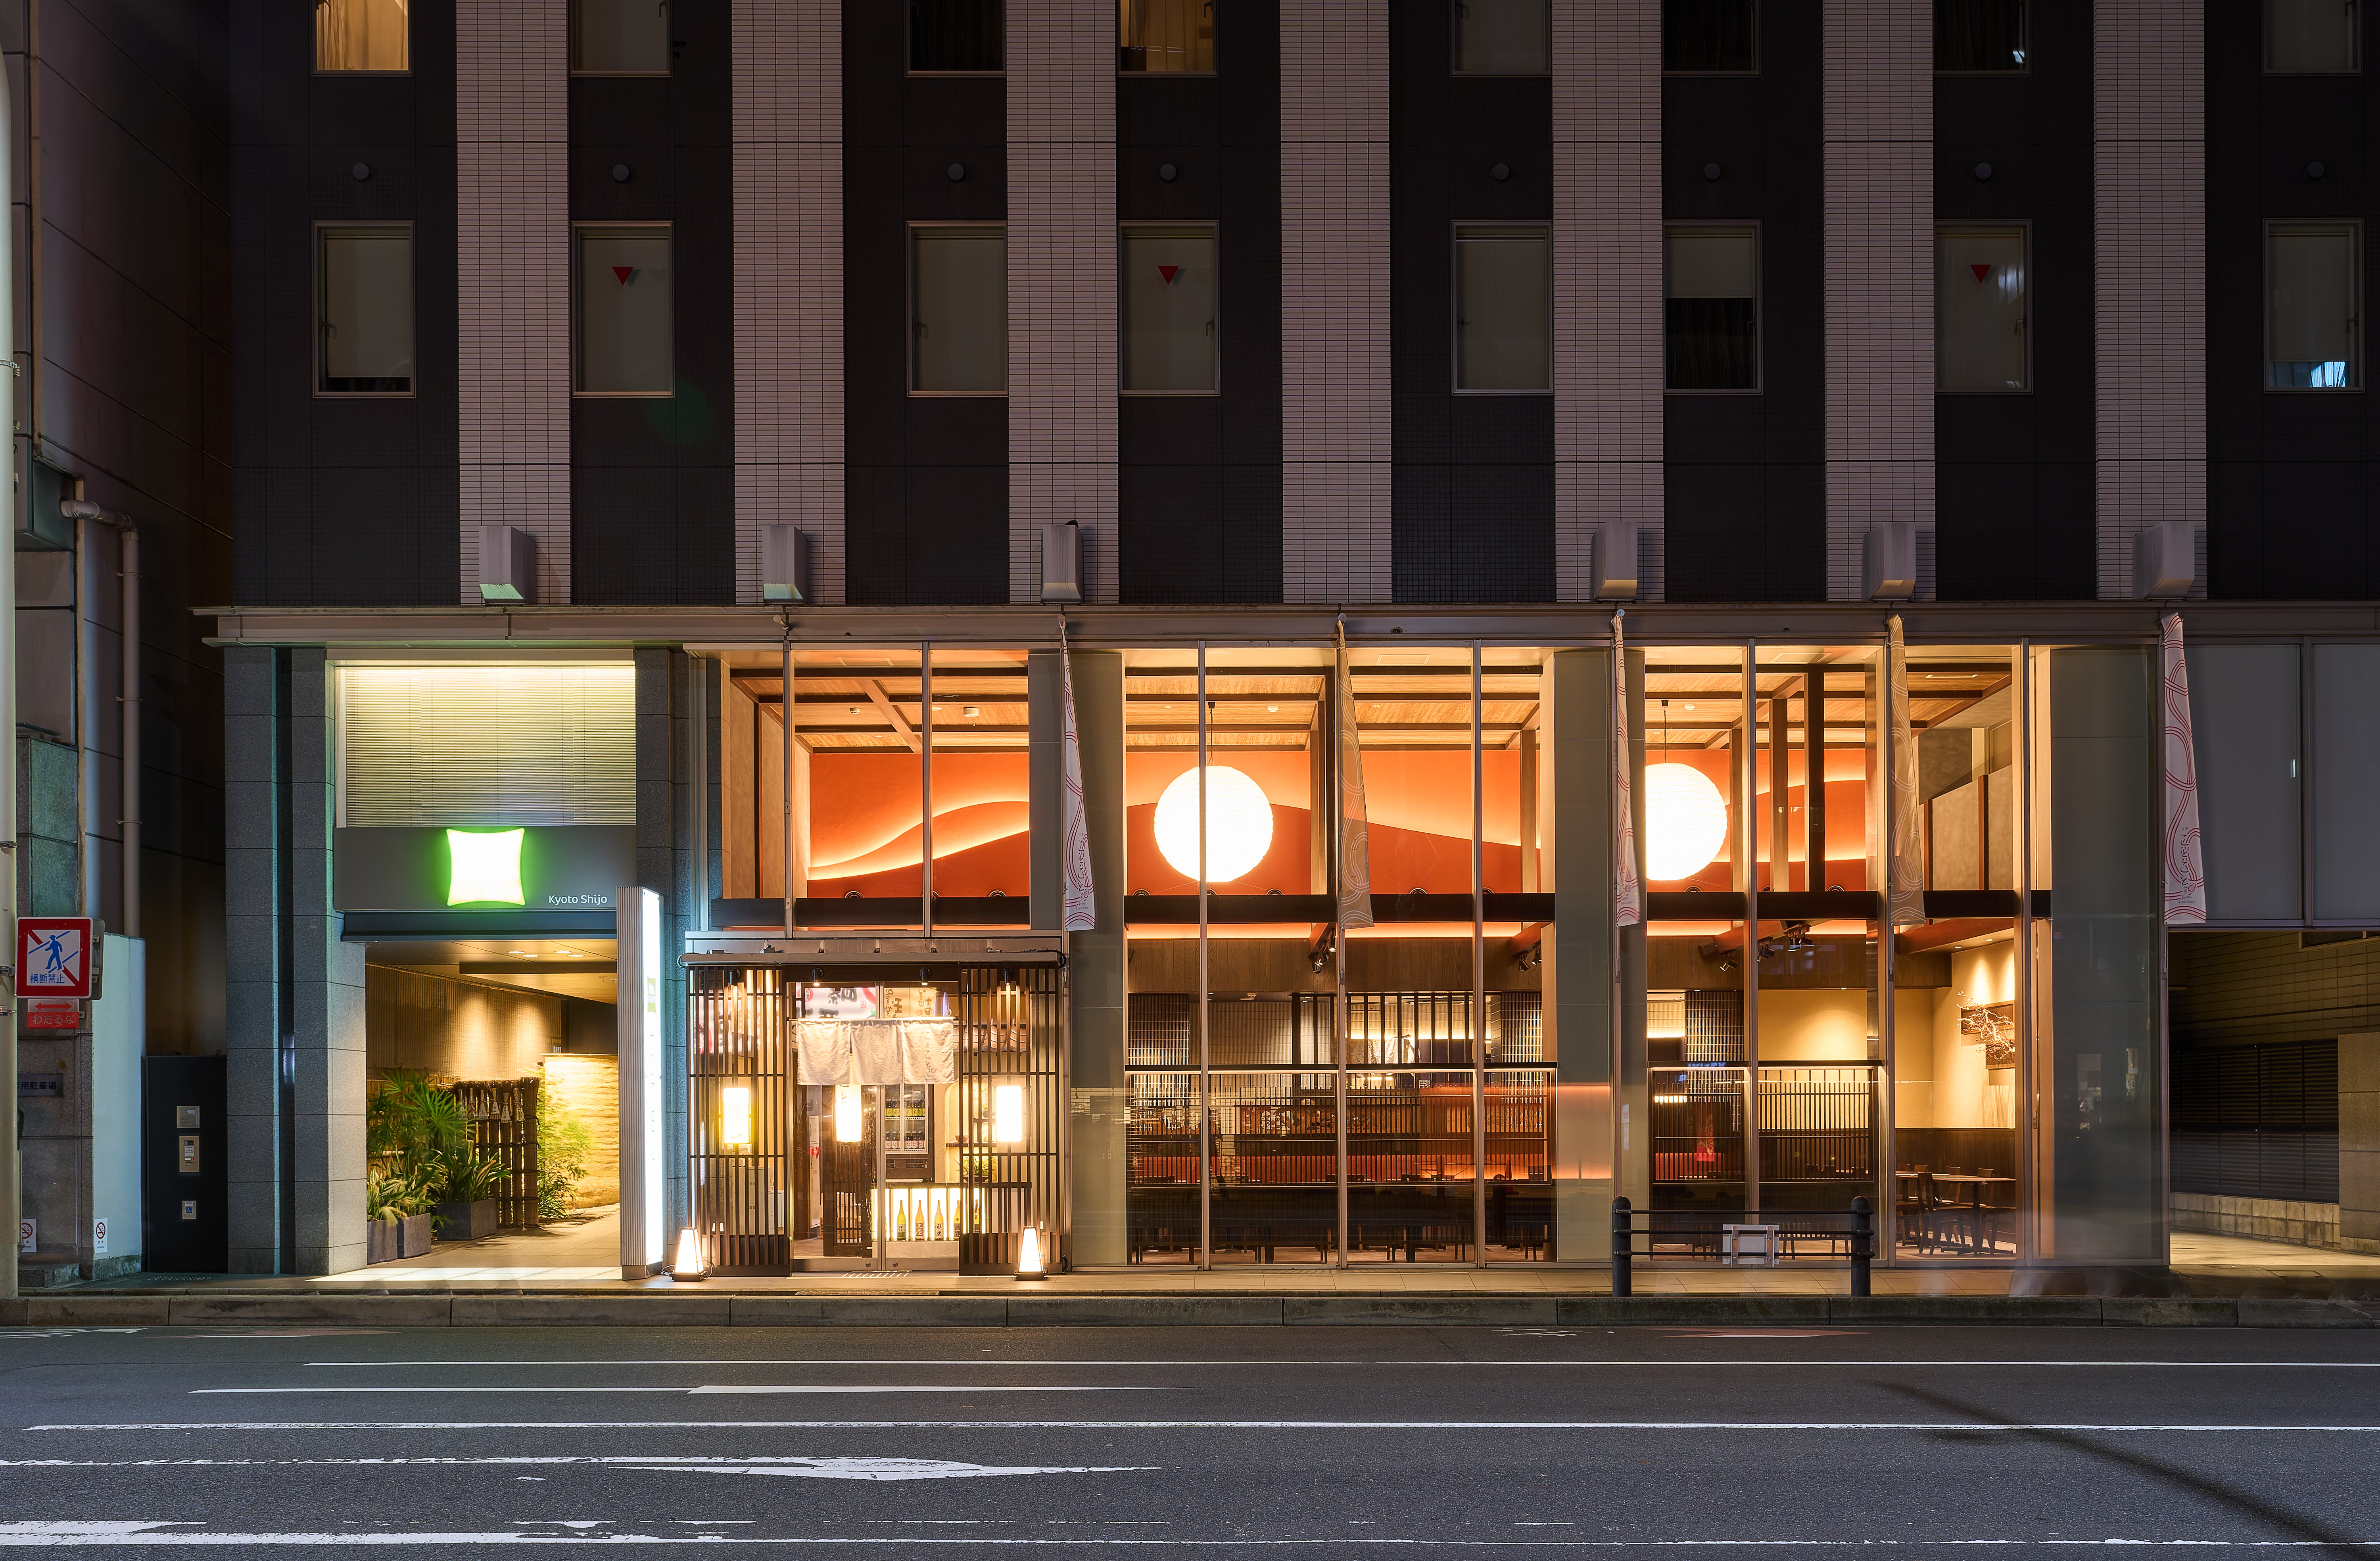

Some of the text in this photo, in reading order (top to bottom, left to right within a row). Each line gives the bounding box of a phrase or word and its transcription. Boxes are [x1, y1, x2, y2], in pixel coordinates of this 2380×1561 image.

[2180, 834, 2189, 885] ことこと
[549, 894, 607, 905] Kyoto Shijo
[30, 973, 65, 984] 横断禁止
[33, 1014, 74, 1024] わたるな
[17, 1081, 56, 1090] 用駐車場
